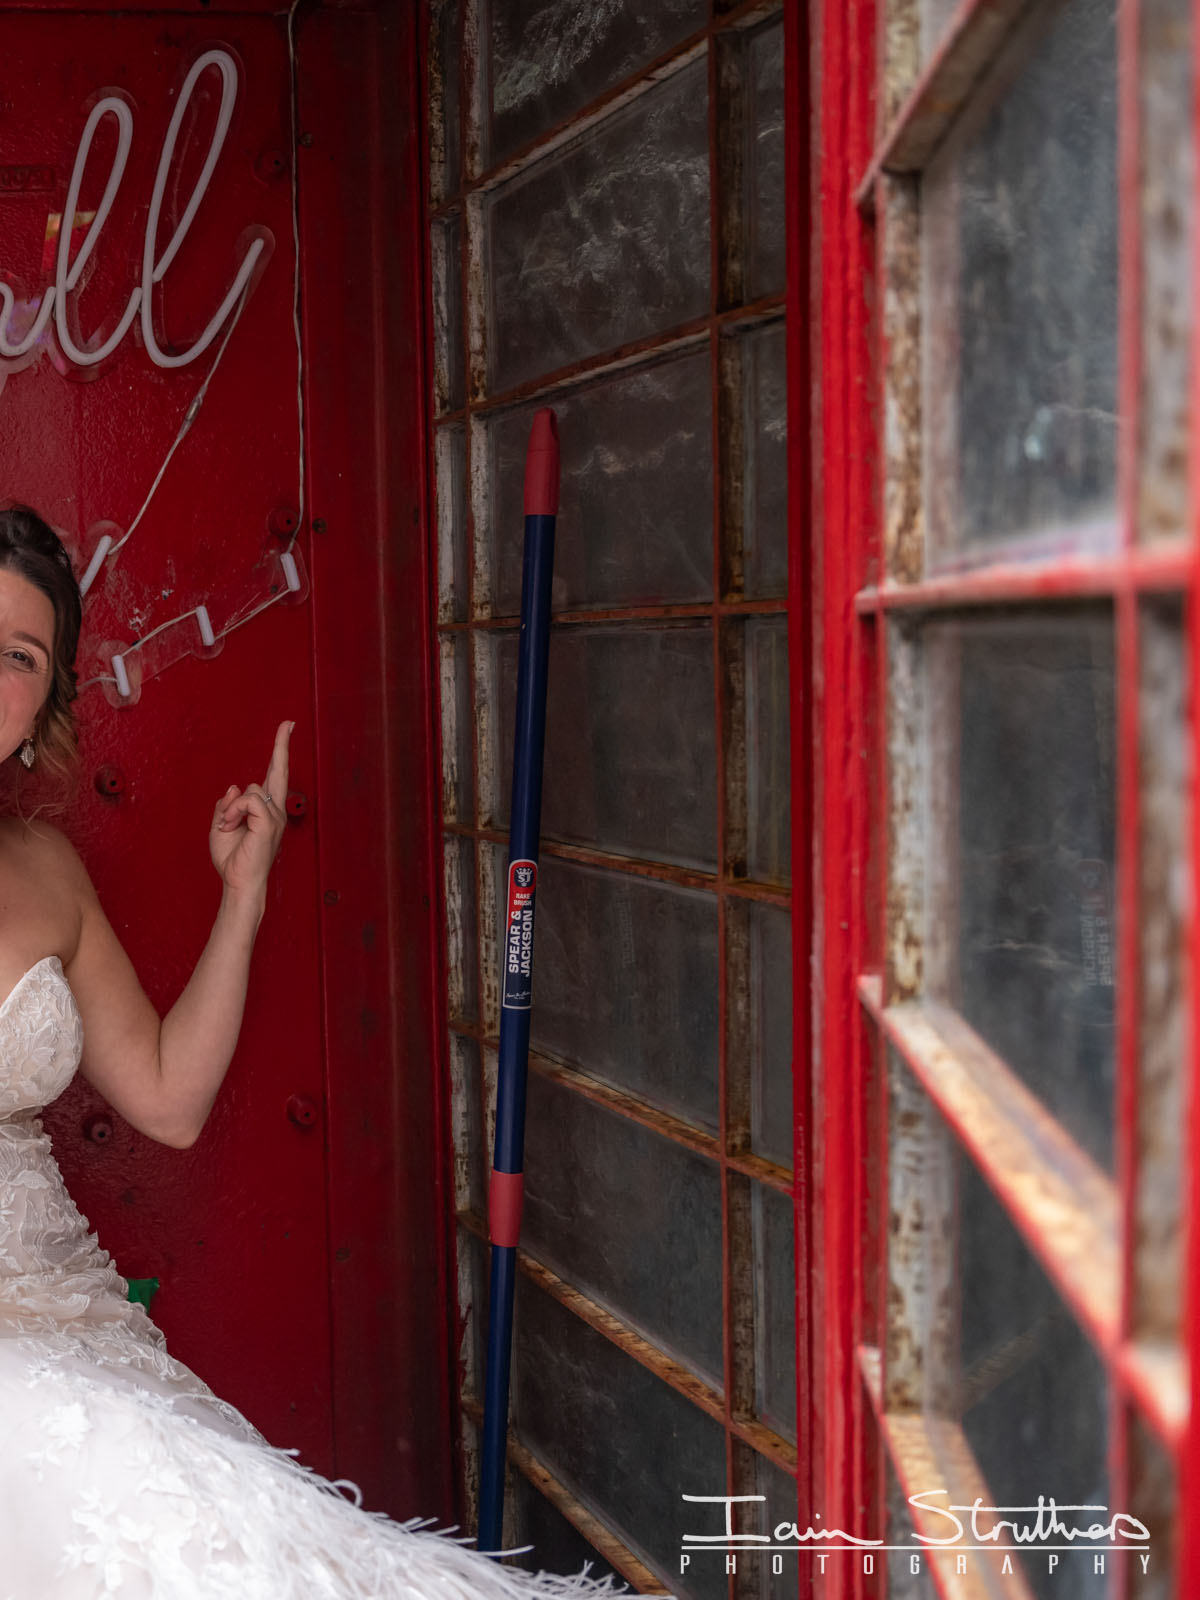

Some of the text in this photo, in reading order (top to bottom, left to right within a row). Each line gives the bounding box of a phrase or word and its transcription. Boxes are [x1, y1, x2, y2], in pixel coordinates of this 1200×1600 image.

[509, 911, 521, 973] SPEAR &
[521, 910, 532, 977] JACKSON
